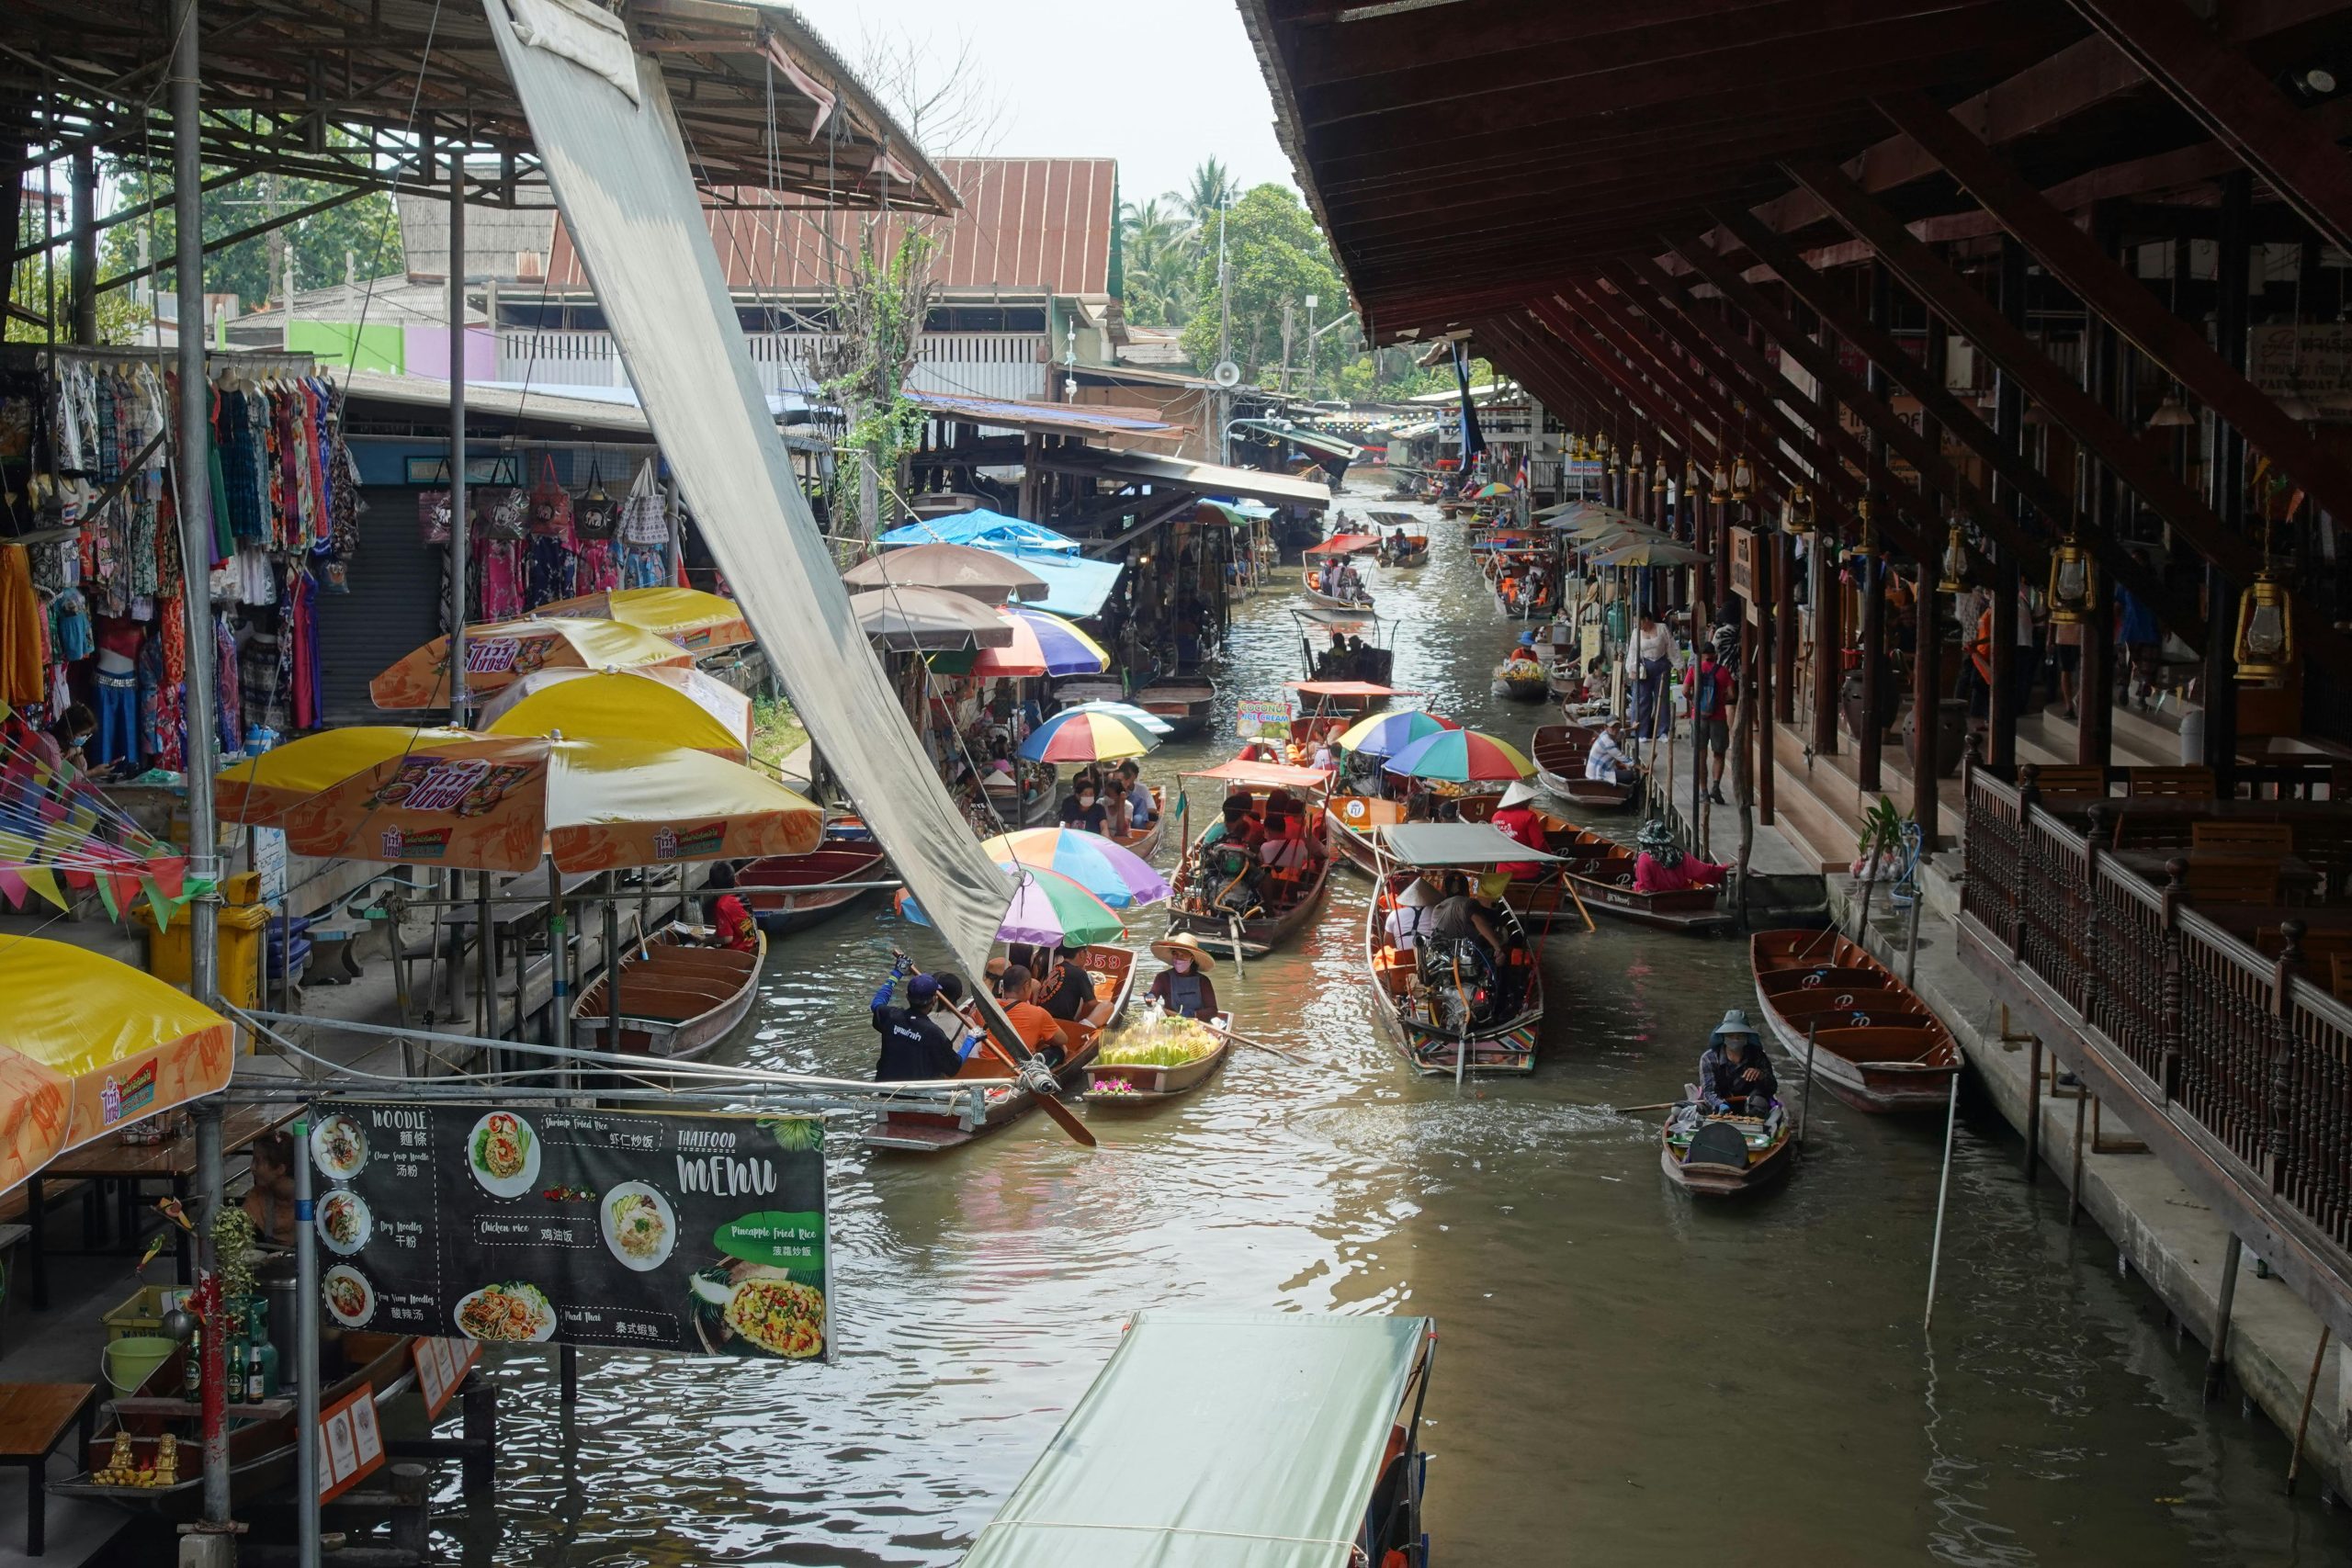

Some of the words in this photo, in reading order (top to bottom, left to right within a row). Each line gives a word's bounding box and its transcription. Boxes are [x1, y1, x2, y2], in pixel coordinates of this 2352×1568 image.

[1241, 704, 1288, 713] COCONUT
[1260, 714, 1289, 722] CREAM
[545, 1117, 571, 1130] Shrimp
[573, 1118, 593, 1130] Fried
[594, 1120, 608, 1132] Rice
[609, 1133, 654, 1148] 虾仁炒饭
[678, 1130, 736, 1148] THAIFOOD
[374, 1151, 390, 1161] Clear
[393, 1151, 407, 1162] Soup
[396, 1164, 418, 1178] 汤粉
[379, 1220, 393, 1235] Dry
[397, 1221, 423, 1234] Noodles
[481, 1221, 510, 1234] Chicken
[513, 1224, 530, 1233] rice
[731, 1226, 770, 1239] Pineapple
[774, 1227, 796, 1240] Fried
[798, 1228, 817, 1241] Rice
[395, 1235, 417, 1248] 干粉
[540, 1228, 573, 1243] 鸡油饭
[378, 1292, 389, 1303] Tom
[391, 1293, 406, 1304] Yum
[410, 1294, 435, 1306] Noodles
[564, 1310, 582, 1321] Phad
[584, 1312, 602, 1323] Thai
